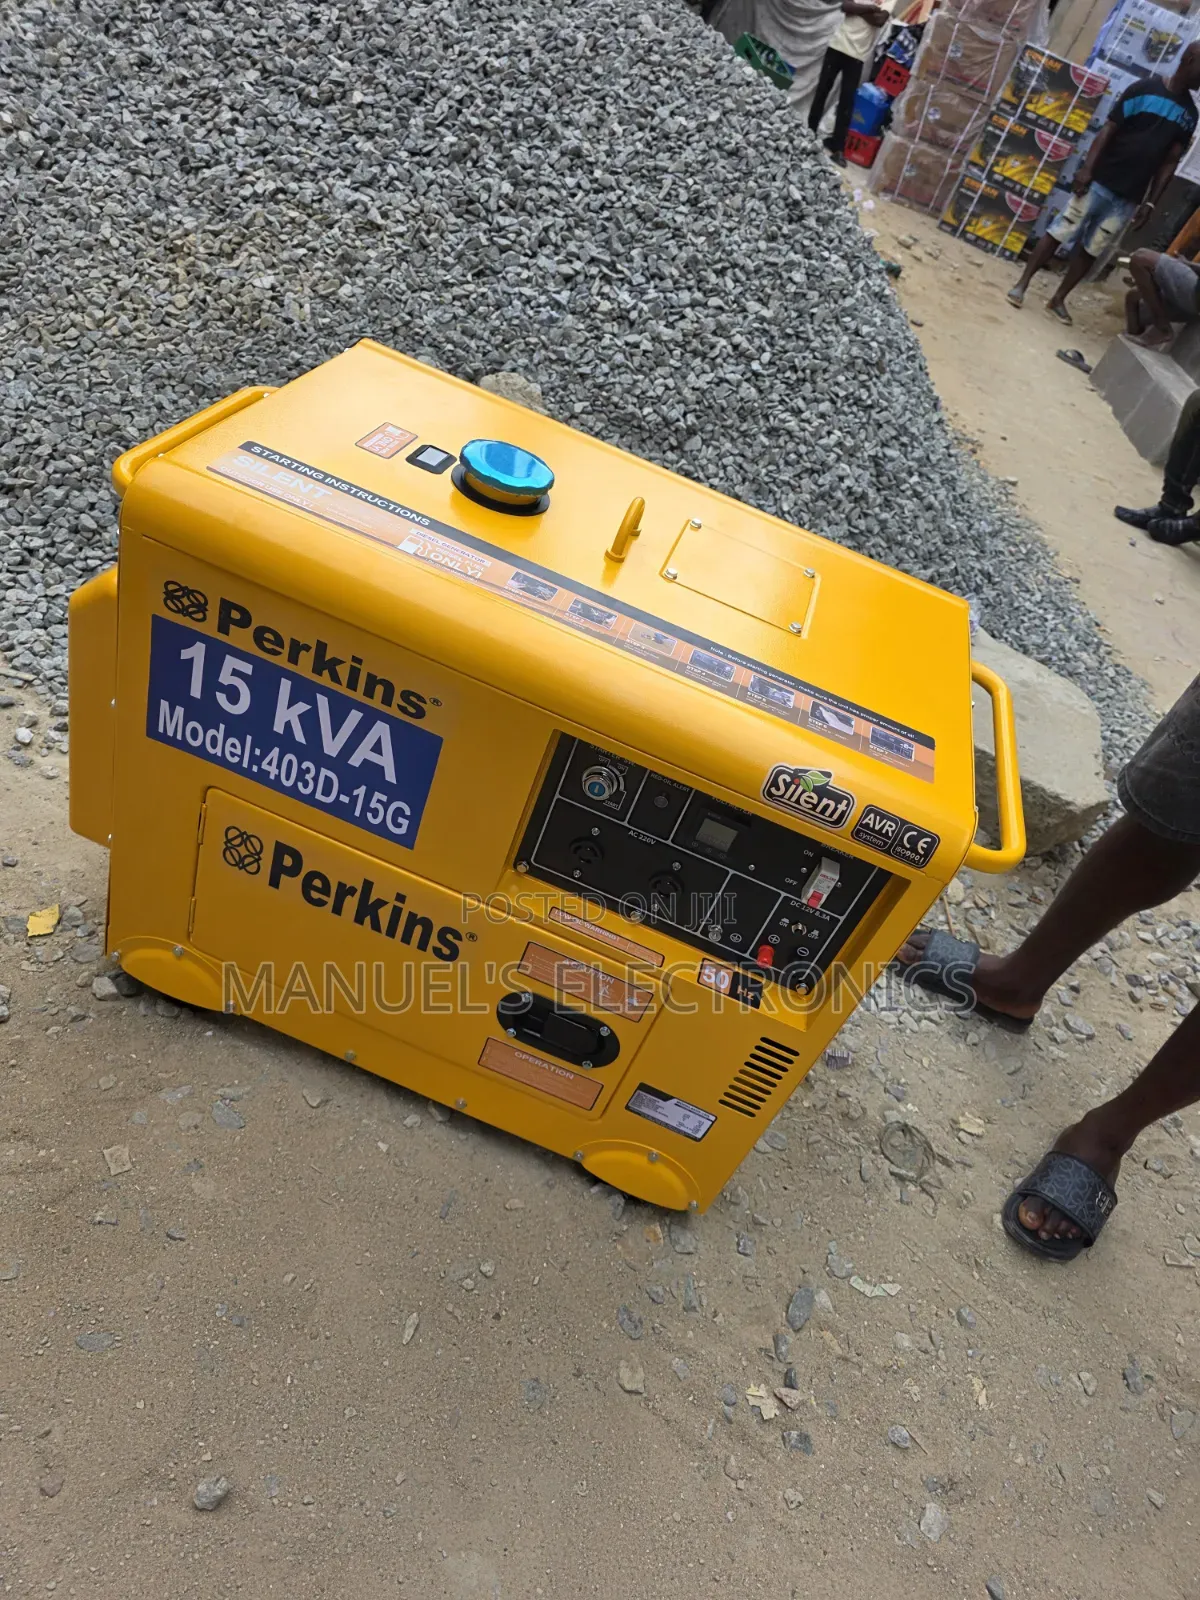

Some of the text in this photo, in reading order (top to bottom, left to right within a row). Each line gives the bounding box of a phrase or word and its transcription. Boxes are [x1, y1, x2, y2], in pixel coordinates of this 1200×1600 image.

[233, 455, 332, 498] SILENT
[251, 446, 323, 479] STARTING
[325, 478, 430, 526] INSTRUCTIONS
[416, 532, 486, 563] DIESEL GENERATOR
[430, 553, 482, 578] ONLY!
[727, 654, 747, 665] Before
[799, 685, 814, 695] make
[815, 692, 828, 700] sure
[179, 640, 397, 785] 15 kVA
[157, 699, 412, 836] Model:403D-15G
[673, 783, 690, 793] ALERT
[770, 773, 849, 820] Silent
[604, 799, 619, 808] START
[862, 812, 897, 837] AVR
[628, 830, 657, 845] AC 220V
[858, 832, 884, 848] system
[903, 831, 932, 855] CE
[803, 849, 814, 858] ON
[894, 845, 925, 863] ISO9001
[785, 877, 798, 886] OFF
[790, 900, 831, 921] DC 12V 8.3A
[702, 965, 754, 1000] 50 Hz
[514, 1051, 575, 1080] OPERATION
